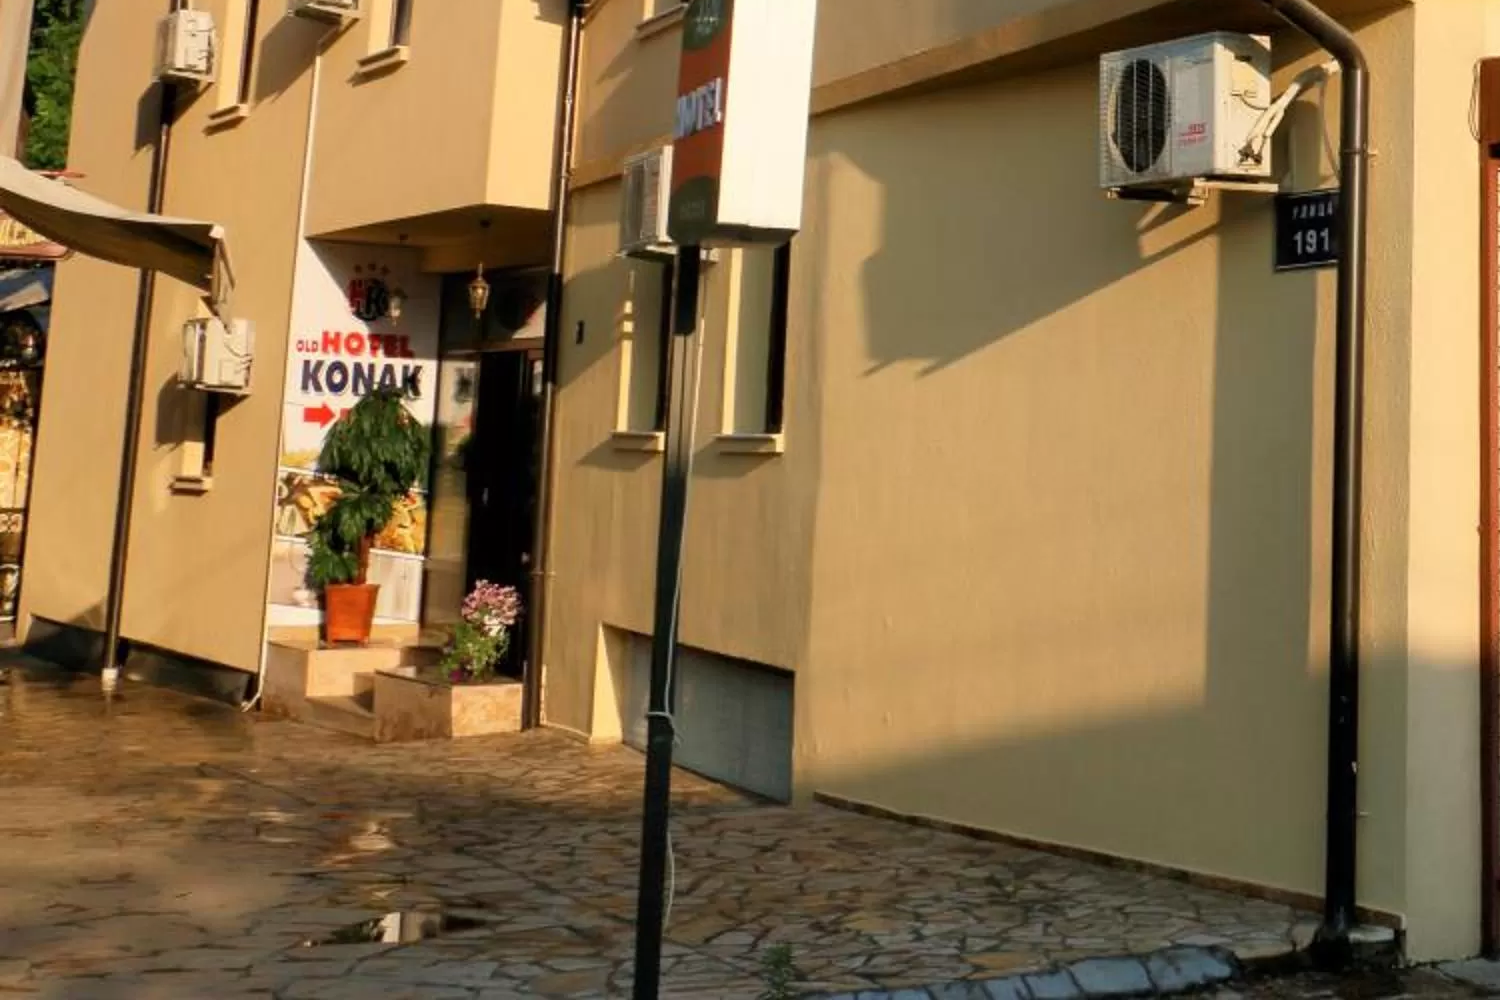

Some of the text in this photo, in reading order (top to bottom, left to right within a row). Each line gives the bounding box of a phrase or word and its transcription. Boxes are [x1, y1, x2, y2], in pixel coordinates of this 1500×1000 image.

[1292, 227, 1330, 256] 191
[296, 330, 415, 358] OLD HOTEL
[301, 360, 423, 397] KONAK
